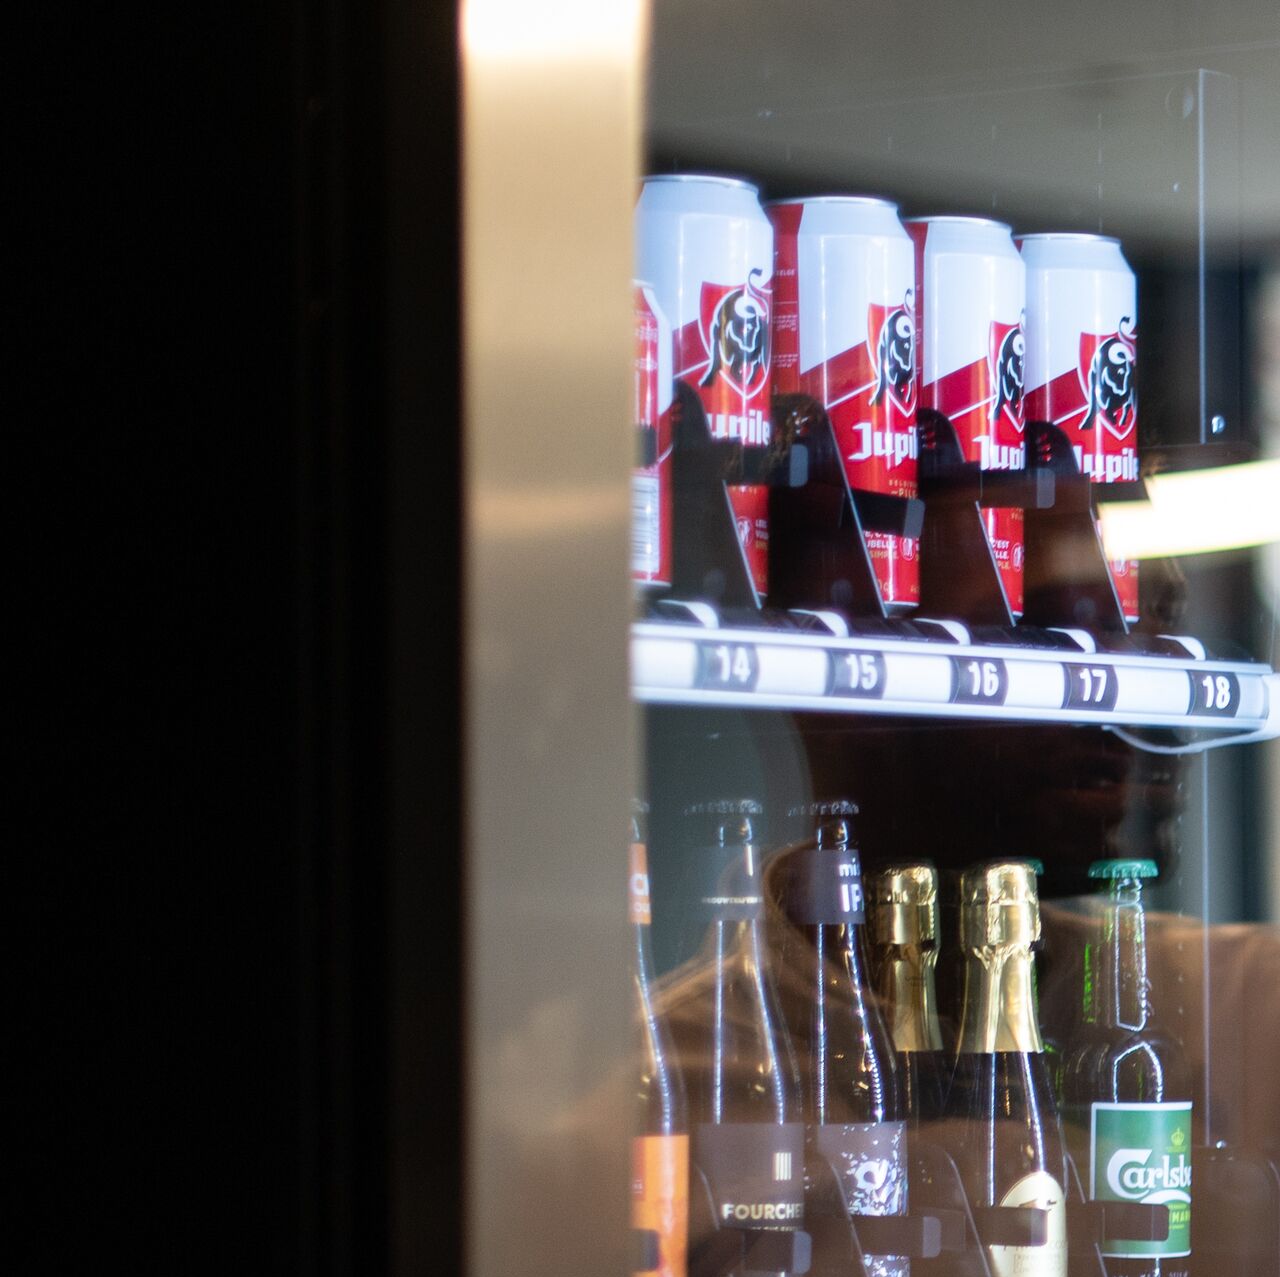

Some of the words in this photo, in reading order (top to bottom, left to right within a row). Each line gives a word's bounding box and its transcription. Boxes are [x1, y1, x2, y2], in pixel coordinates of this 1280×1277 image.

[715, 646, 751, 682] 14
[845, 654, 878, 690] 15
[968, 661, 1000, 697] 16
[1080, 668, 1107, 702] 17
[1203, 675, 1231, 709] 18
[842, 884, 864, 912] IP
